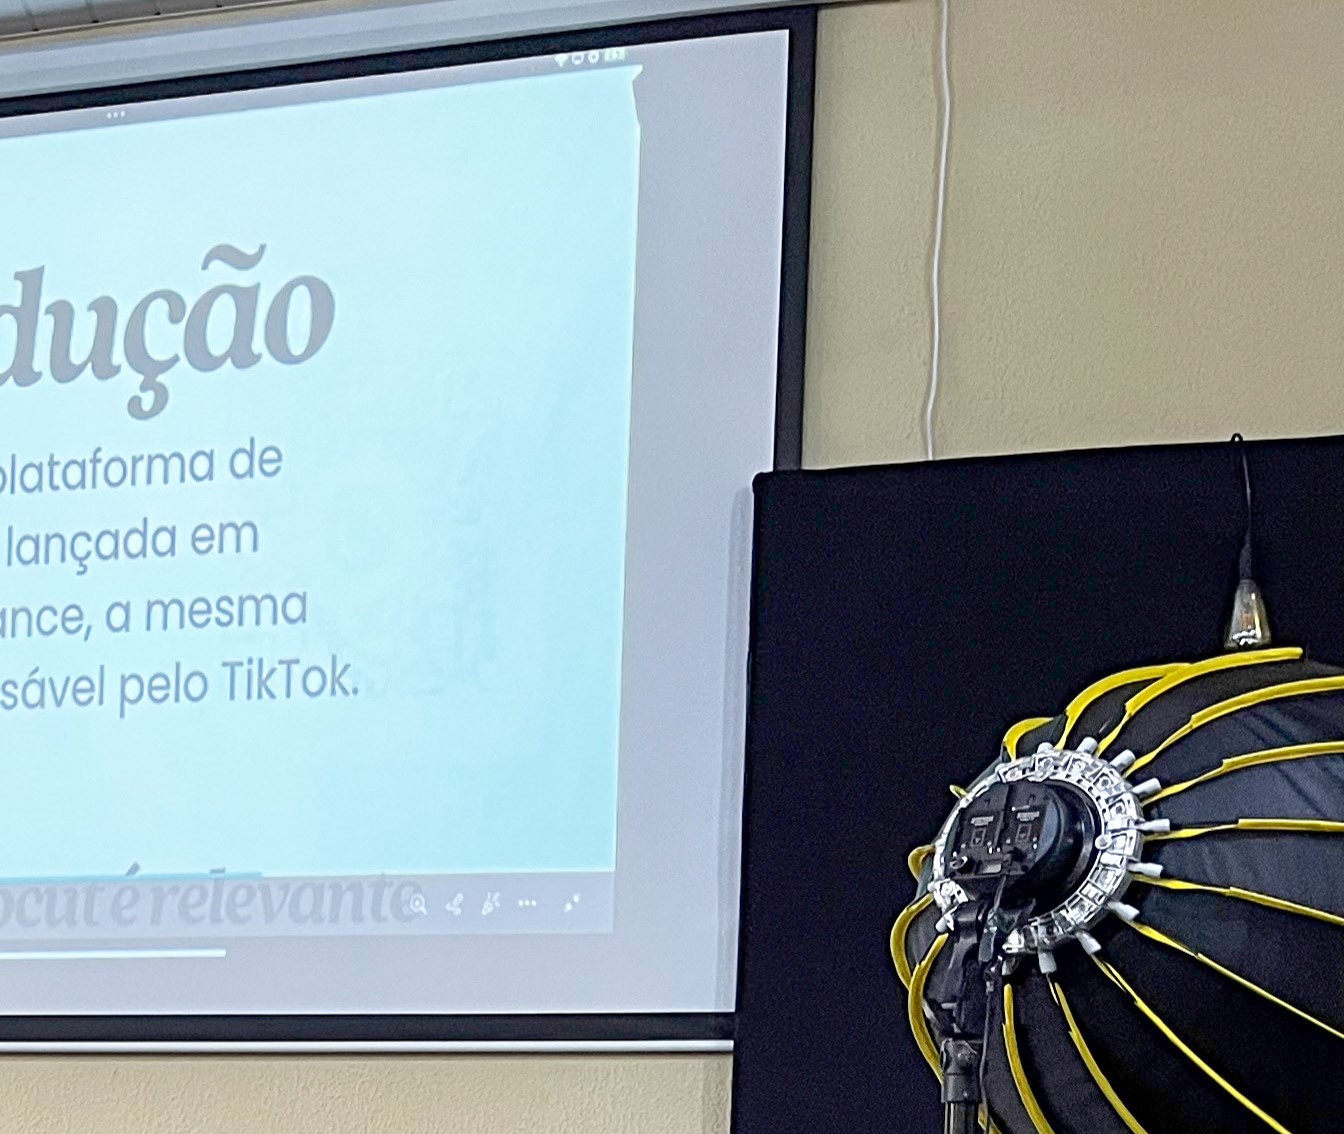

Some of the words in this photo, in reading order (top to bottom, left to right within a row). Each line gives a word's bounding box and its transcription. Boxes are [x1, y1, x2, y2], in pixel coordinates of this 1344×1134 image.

[227, 435, 284, 481] de
[5, 515, 177, 577] lançada
[189, 519, 260, 557] em
[104, 599, 132, 634] a
[144, 591, 308, 633] mesma
[118, 660, 210, 721] pelo
[220, 653, 360, 703] TikTok.
[111, 861, 142, 927] é
[149, 867, 424, 926] relevante
